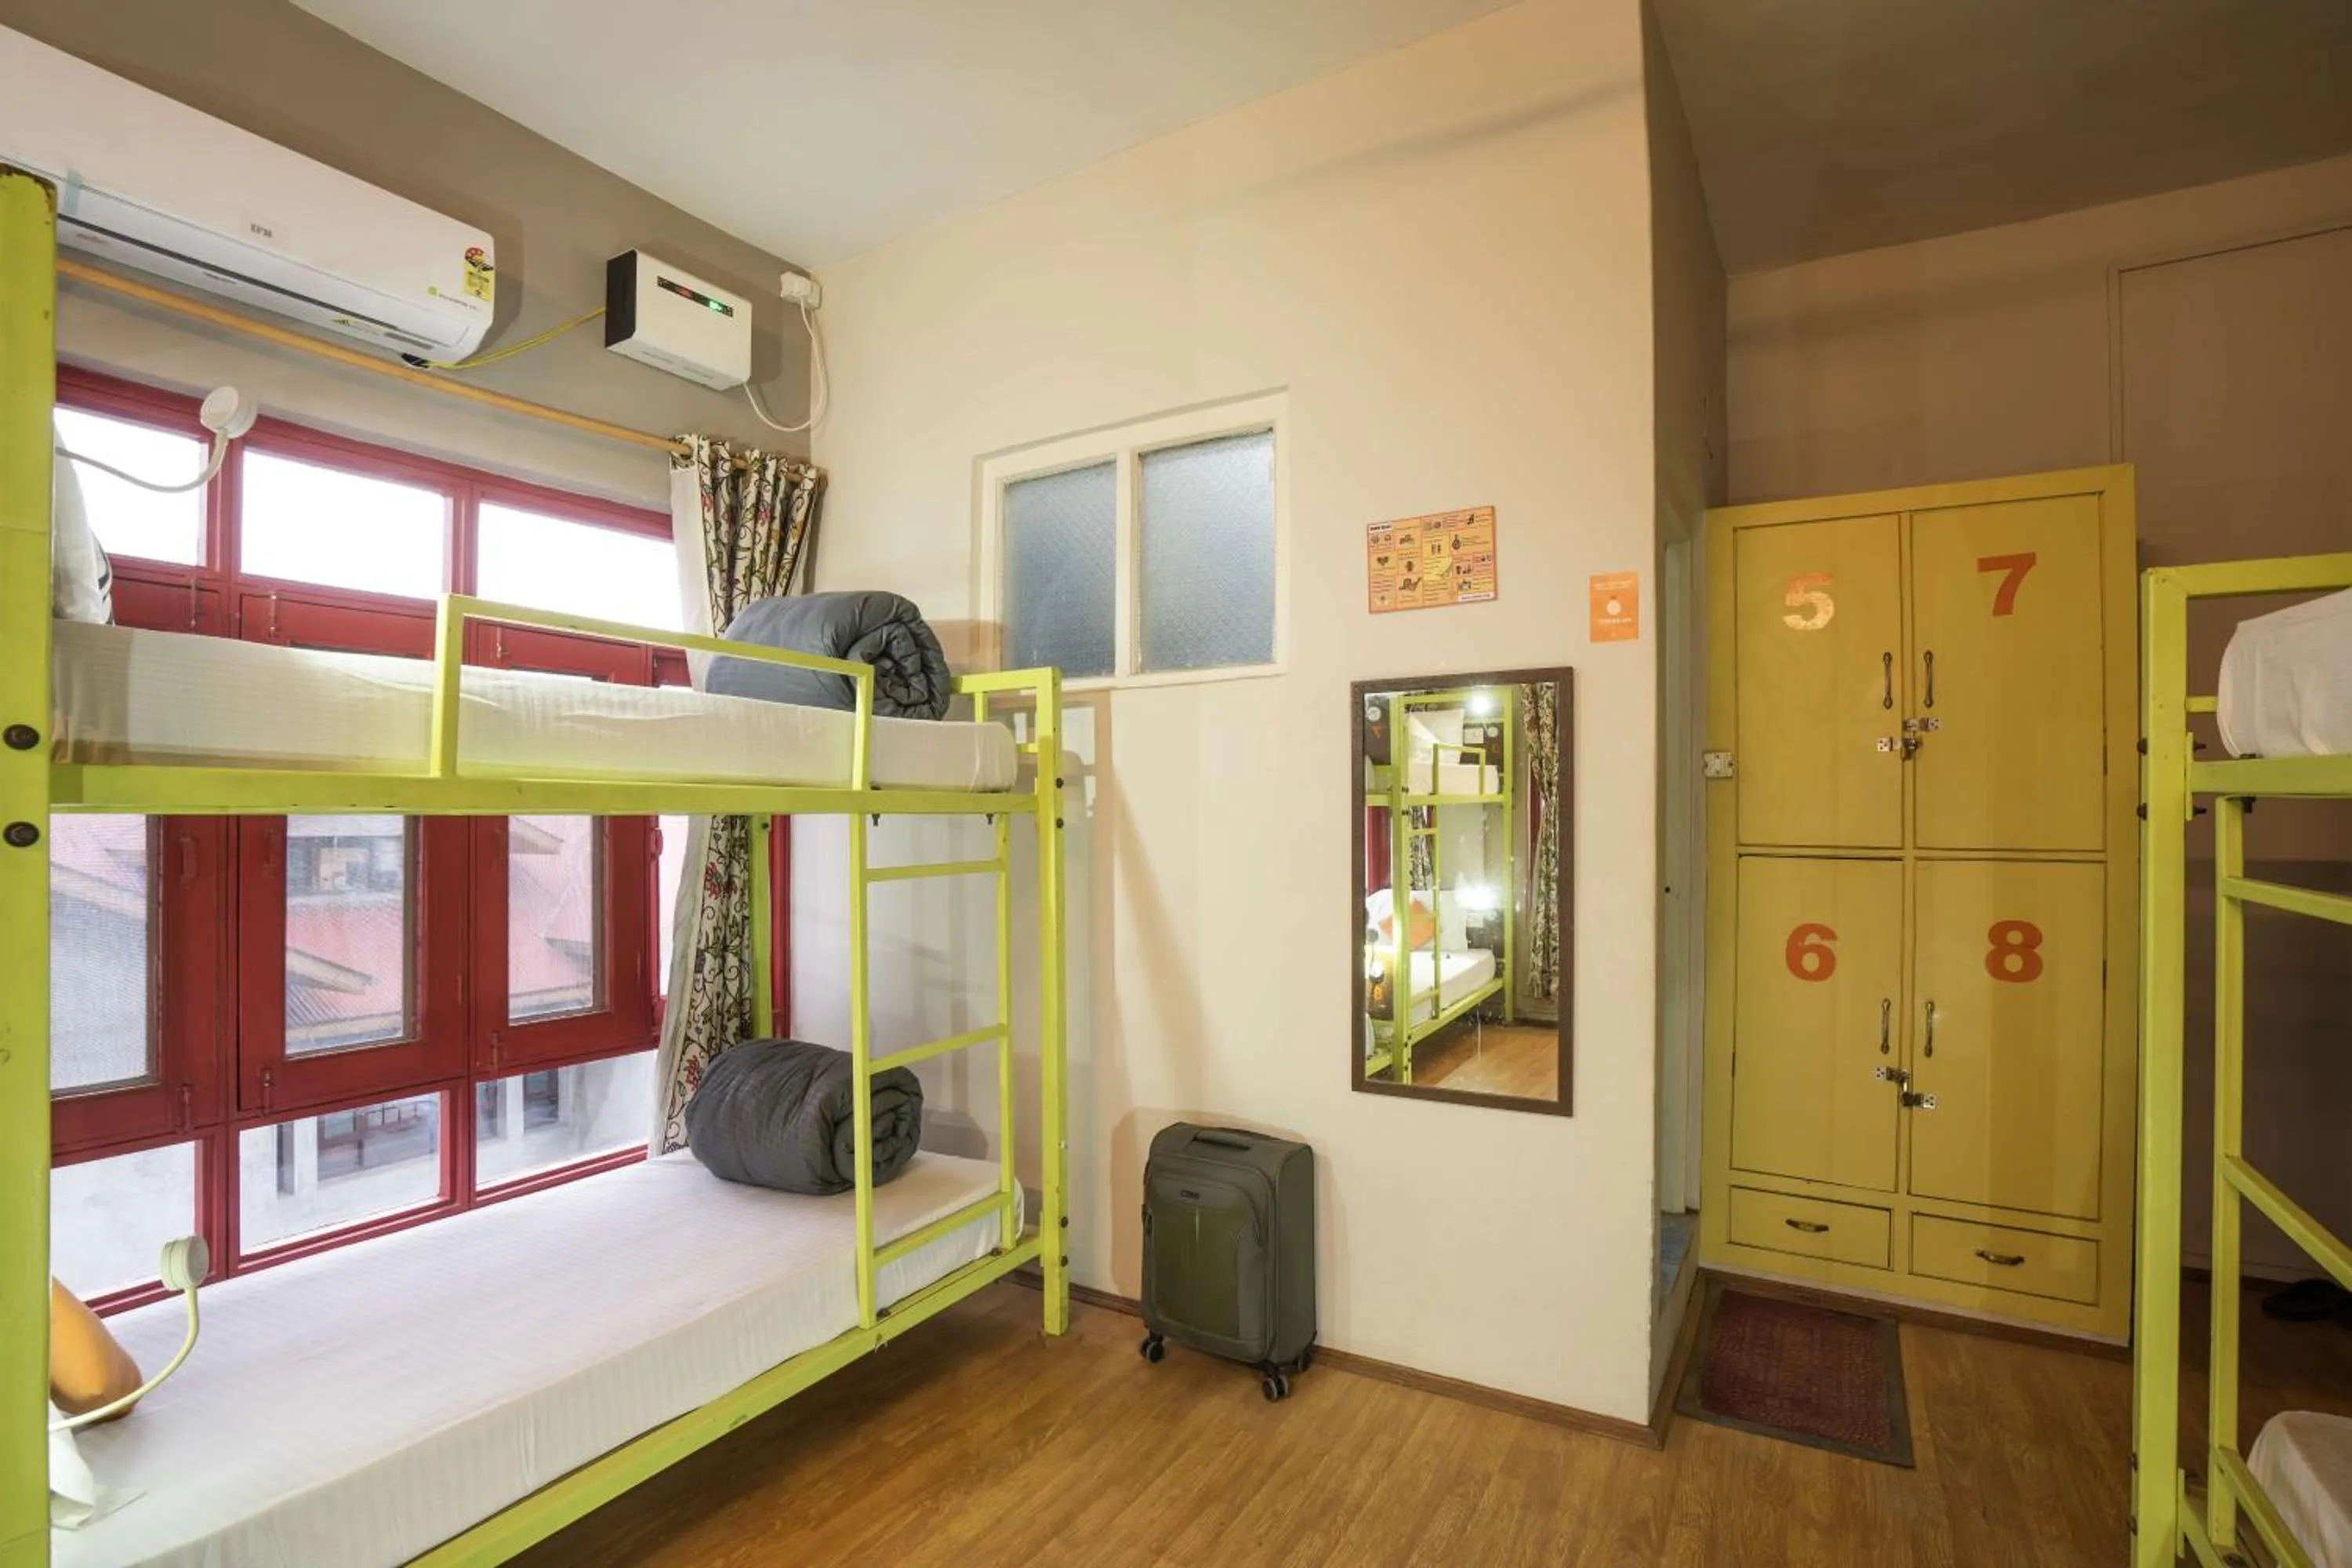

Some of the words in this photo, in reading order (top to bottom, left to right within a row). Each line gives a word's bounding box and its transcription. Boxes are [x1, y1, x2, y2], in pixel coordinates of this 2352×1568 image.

[1782, 573, 1835, 630] 5
[1977, 552, 2037, 616] 7
[1785, 923, 1837, 982] 6
[1984, 920, 2043, 983] 8
